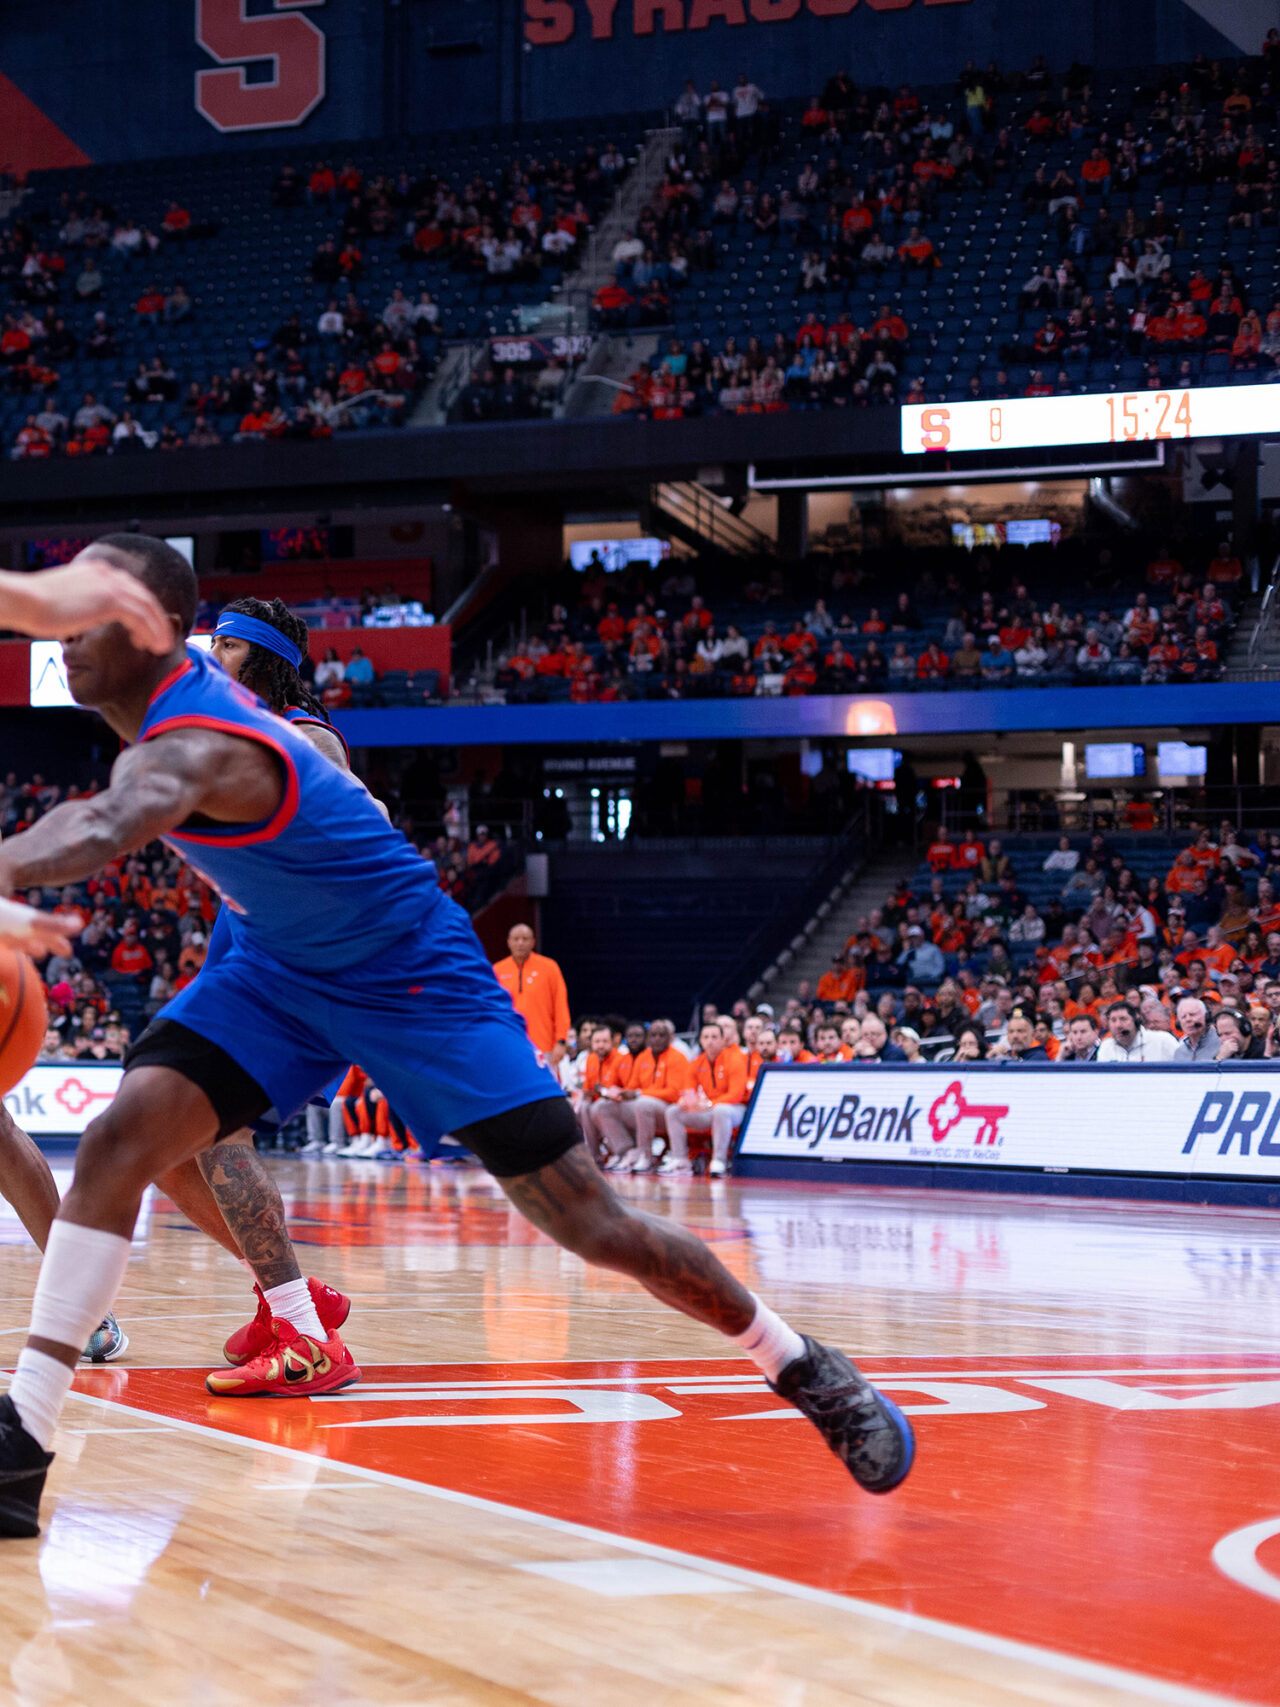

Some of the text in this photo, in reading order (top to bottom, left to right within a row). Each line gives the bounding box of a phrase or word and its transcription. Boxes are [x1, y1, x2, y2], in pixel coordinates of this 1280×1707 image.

[195, 0, 326, 133] S
[990, 407, 1002, 442] 8
[1106, 391, 1193, 442] 15:24
[773, 1093, 923, 1149] KeyBank
